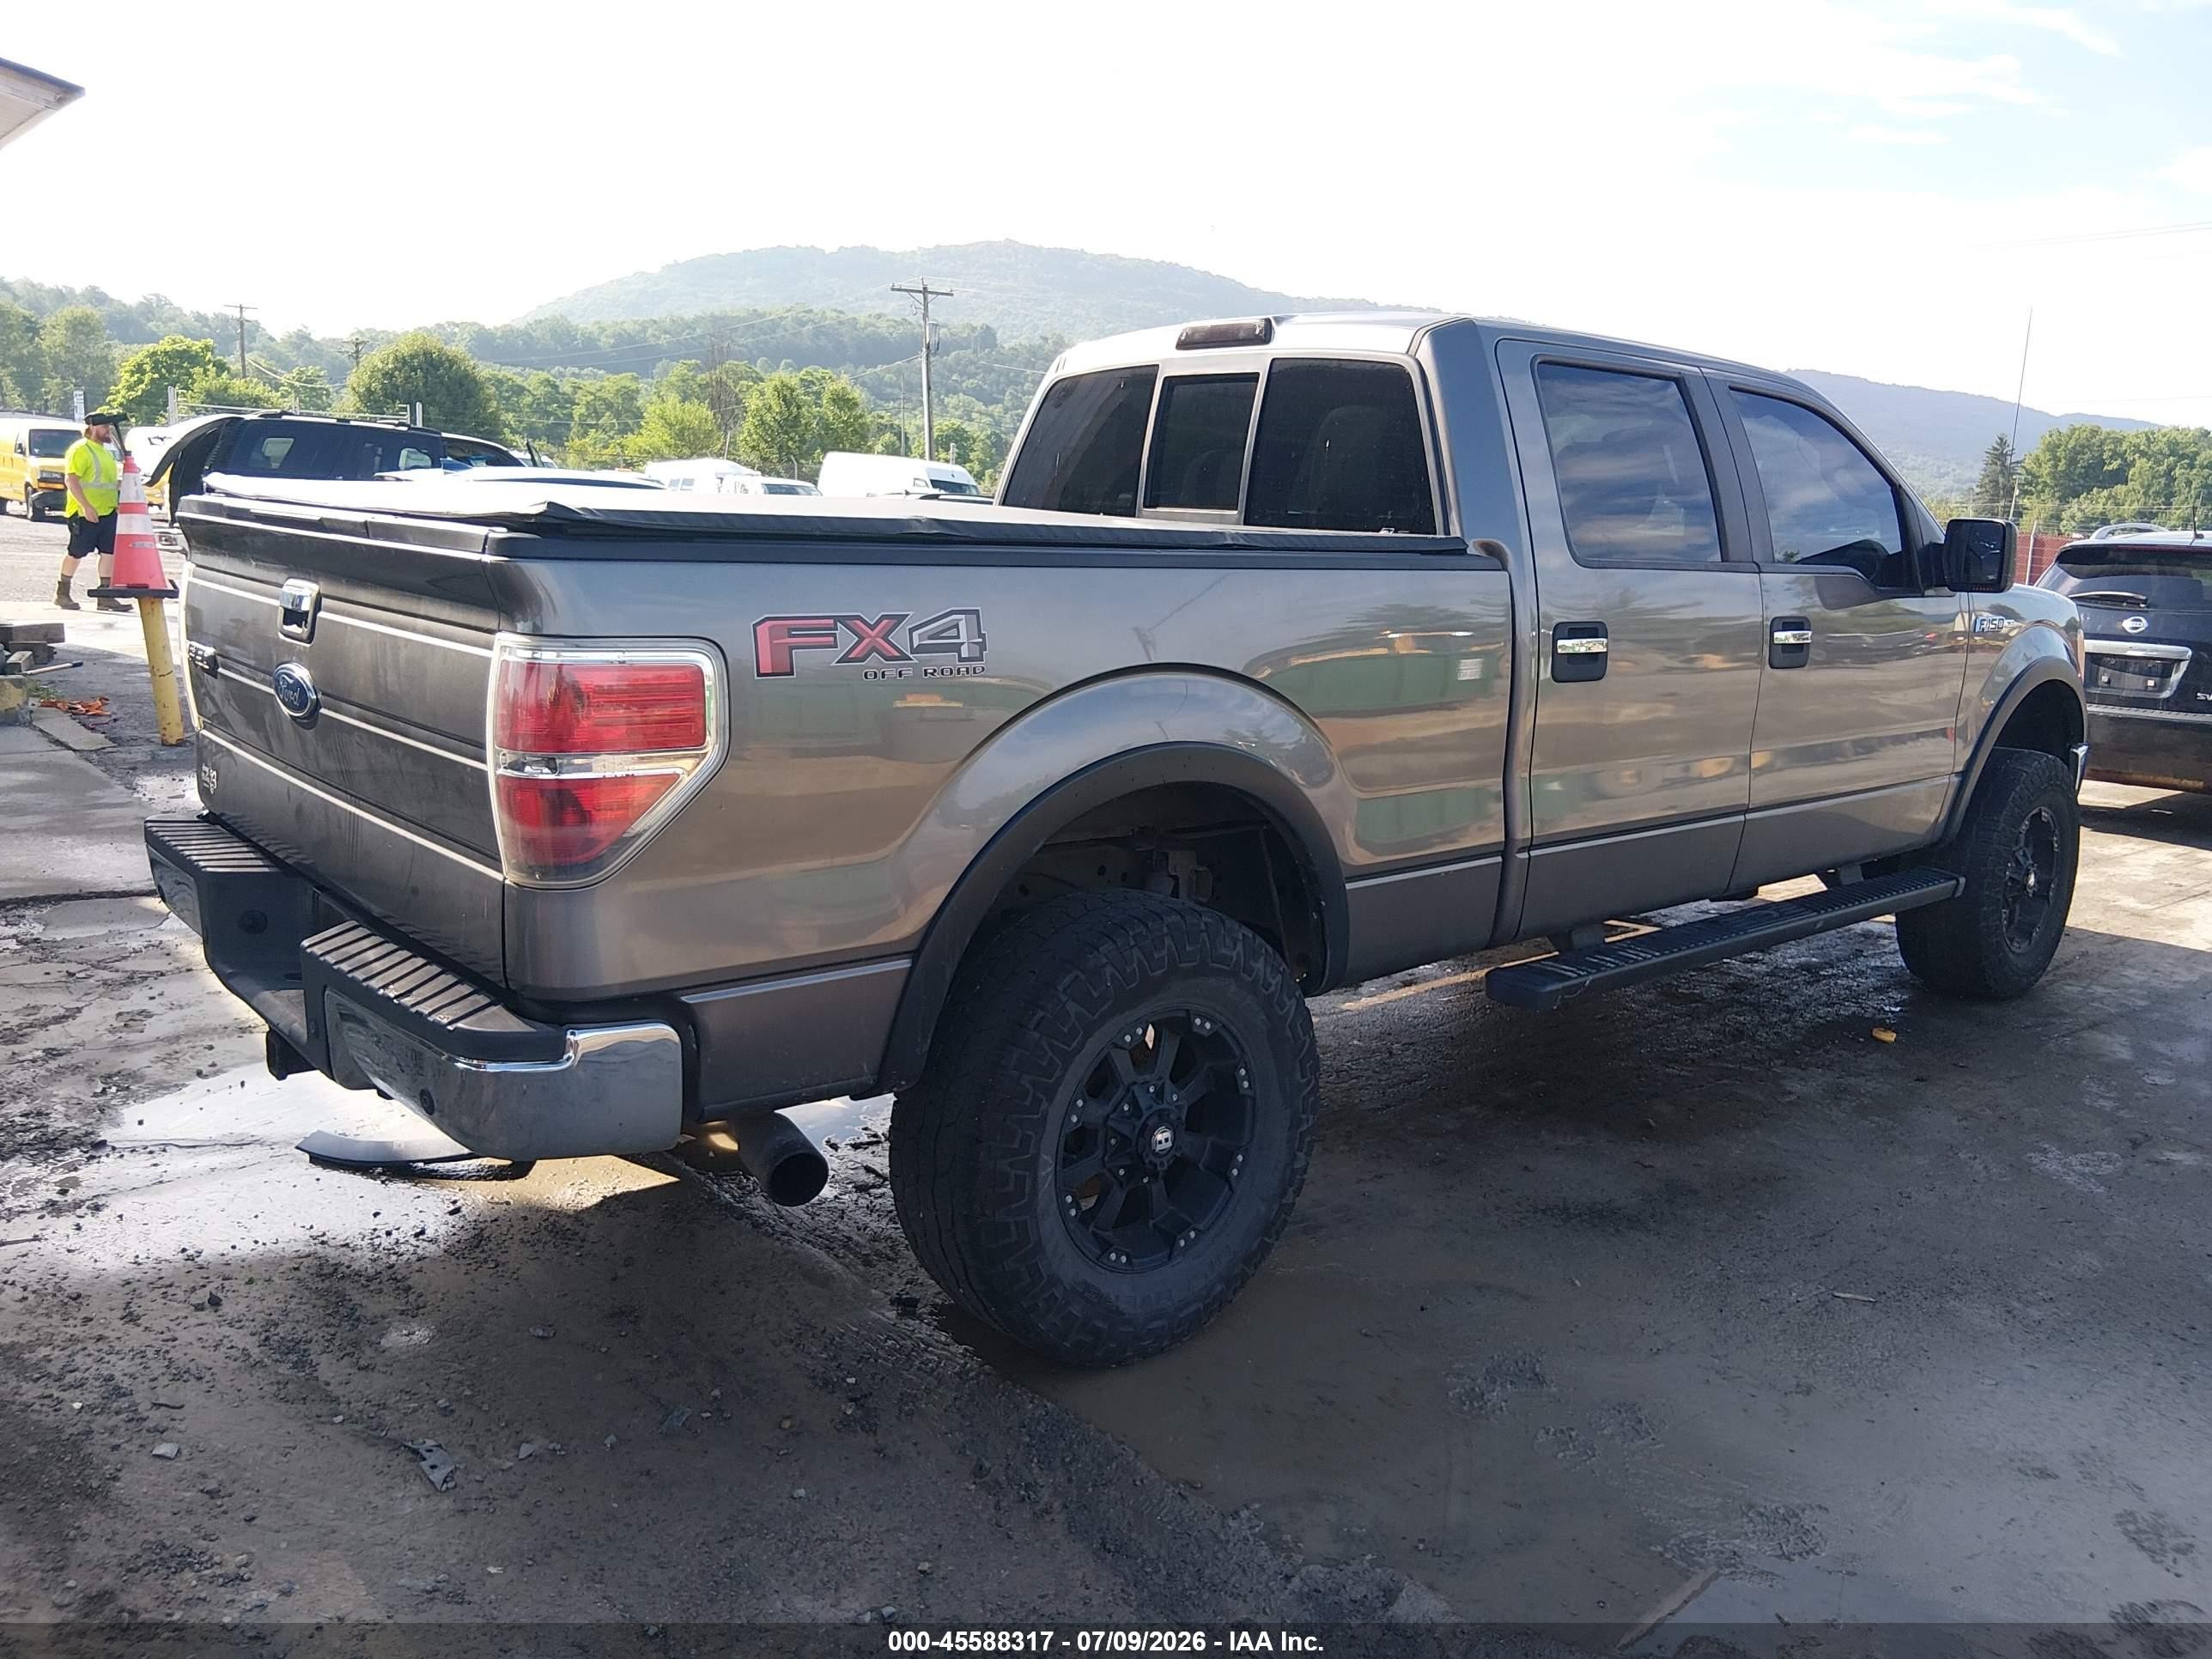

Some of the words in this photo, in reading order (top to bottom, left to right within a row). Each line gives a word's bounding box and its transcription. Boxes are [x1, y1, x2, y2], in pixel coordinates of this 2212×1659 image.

[752, 607, 988, 678] FX4
[862, 667, 914, 681] OFF
[923, 665, 987, 678] ROAD
[278, 674, 301, 707] Ford
